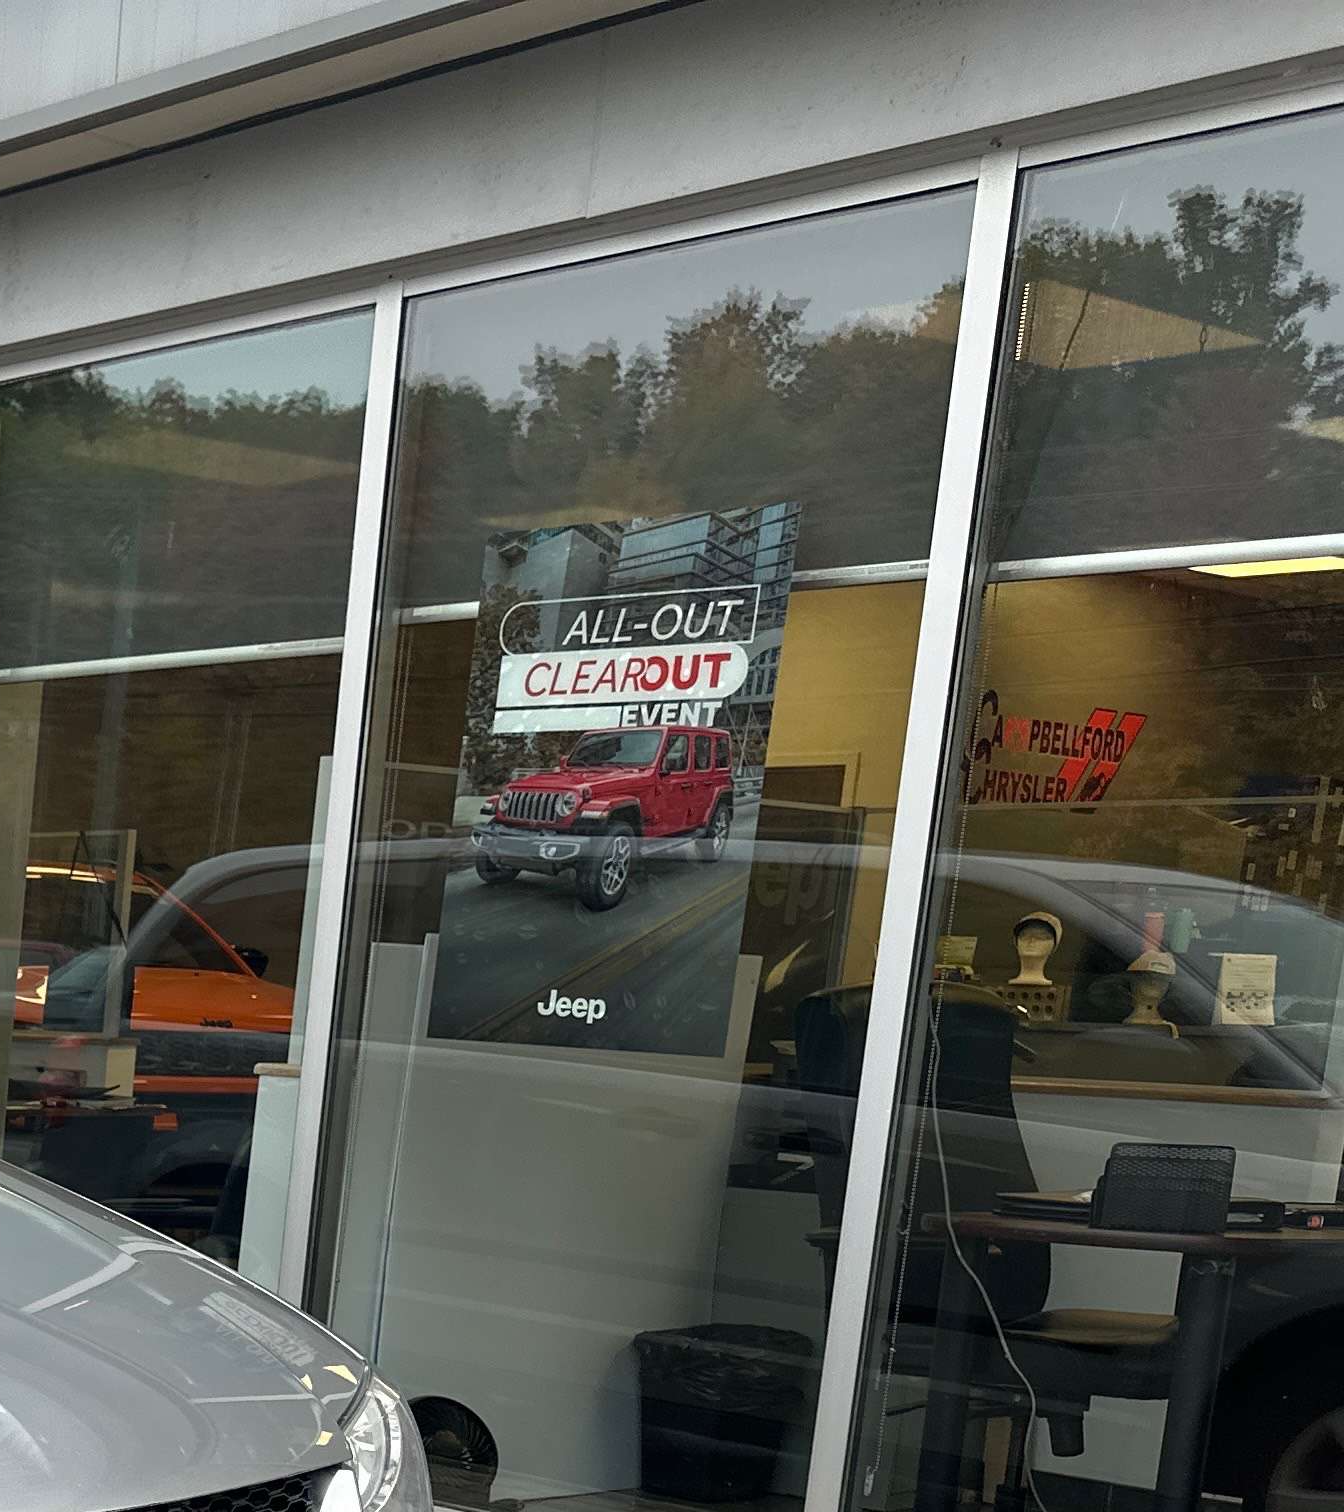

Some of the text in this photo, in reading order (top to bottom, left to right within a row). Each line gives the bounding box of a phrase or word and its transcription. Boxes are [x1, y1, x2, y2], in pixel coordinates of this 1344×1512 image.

[562, 599, 745, 647] ALL-OUT
[619, 701, 723, 729] EVENT
[537, 989, 607, 1024] Jeep
